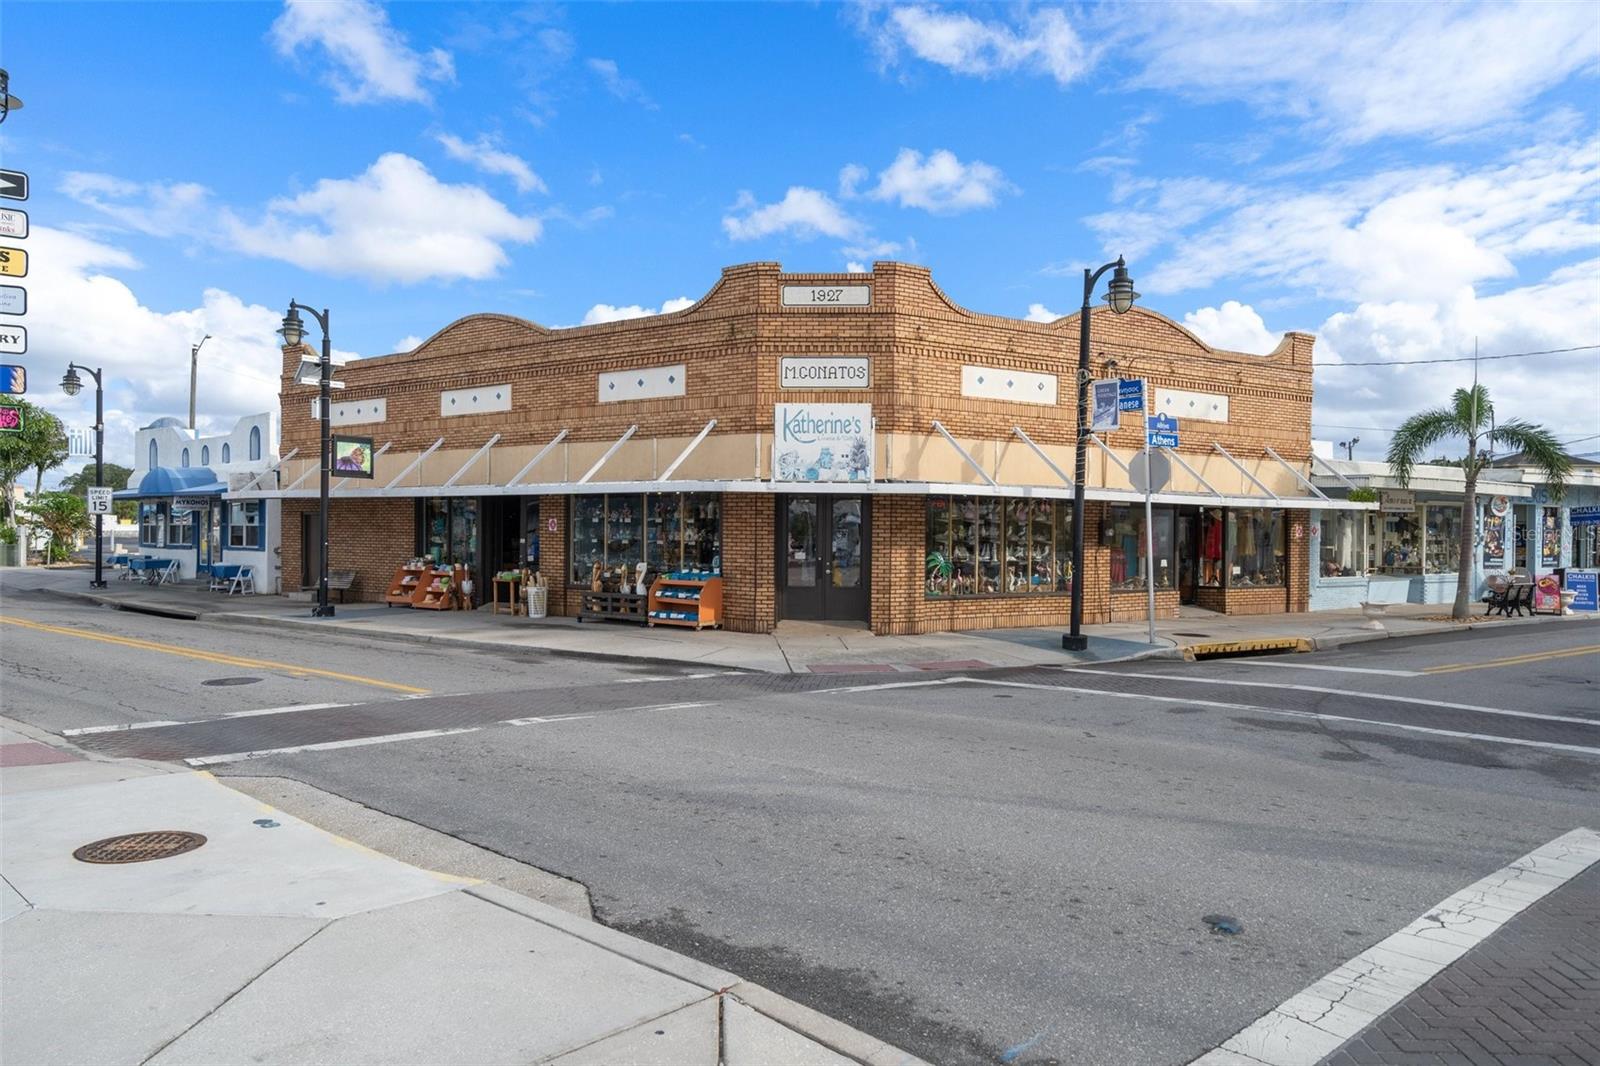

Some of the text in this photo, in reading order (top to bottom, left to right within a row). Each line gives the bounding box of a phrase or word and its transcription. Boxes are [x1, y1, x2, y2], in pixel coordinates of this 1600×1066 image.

[811, 290, 844, 302] 1927
[783, 407, 862, 444] Katherine's
[1151, 435, 1175, 446] Athens
[93, 501, 108, 511] 15
